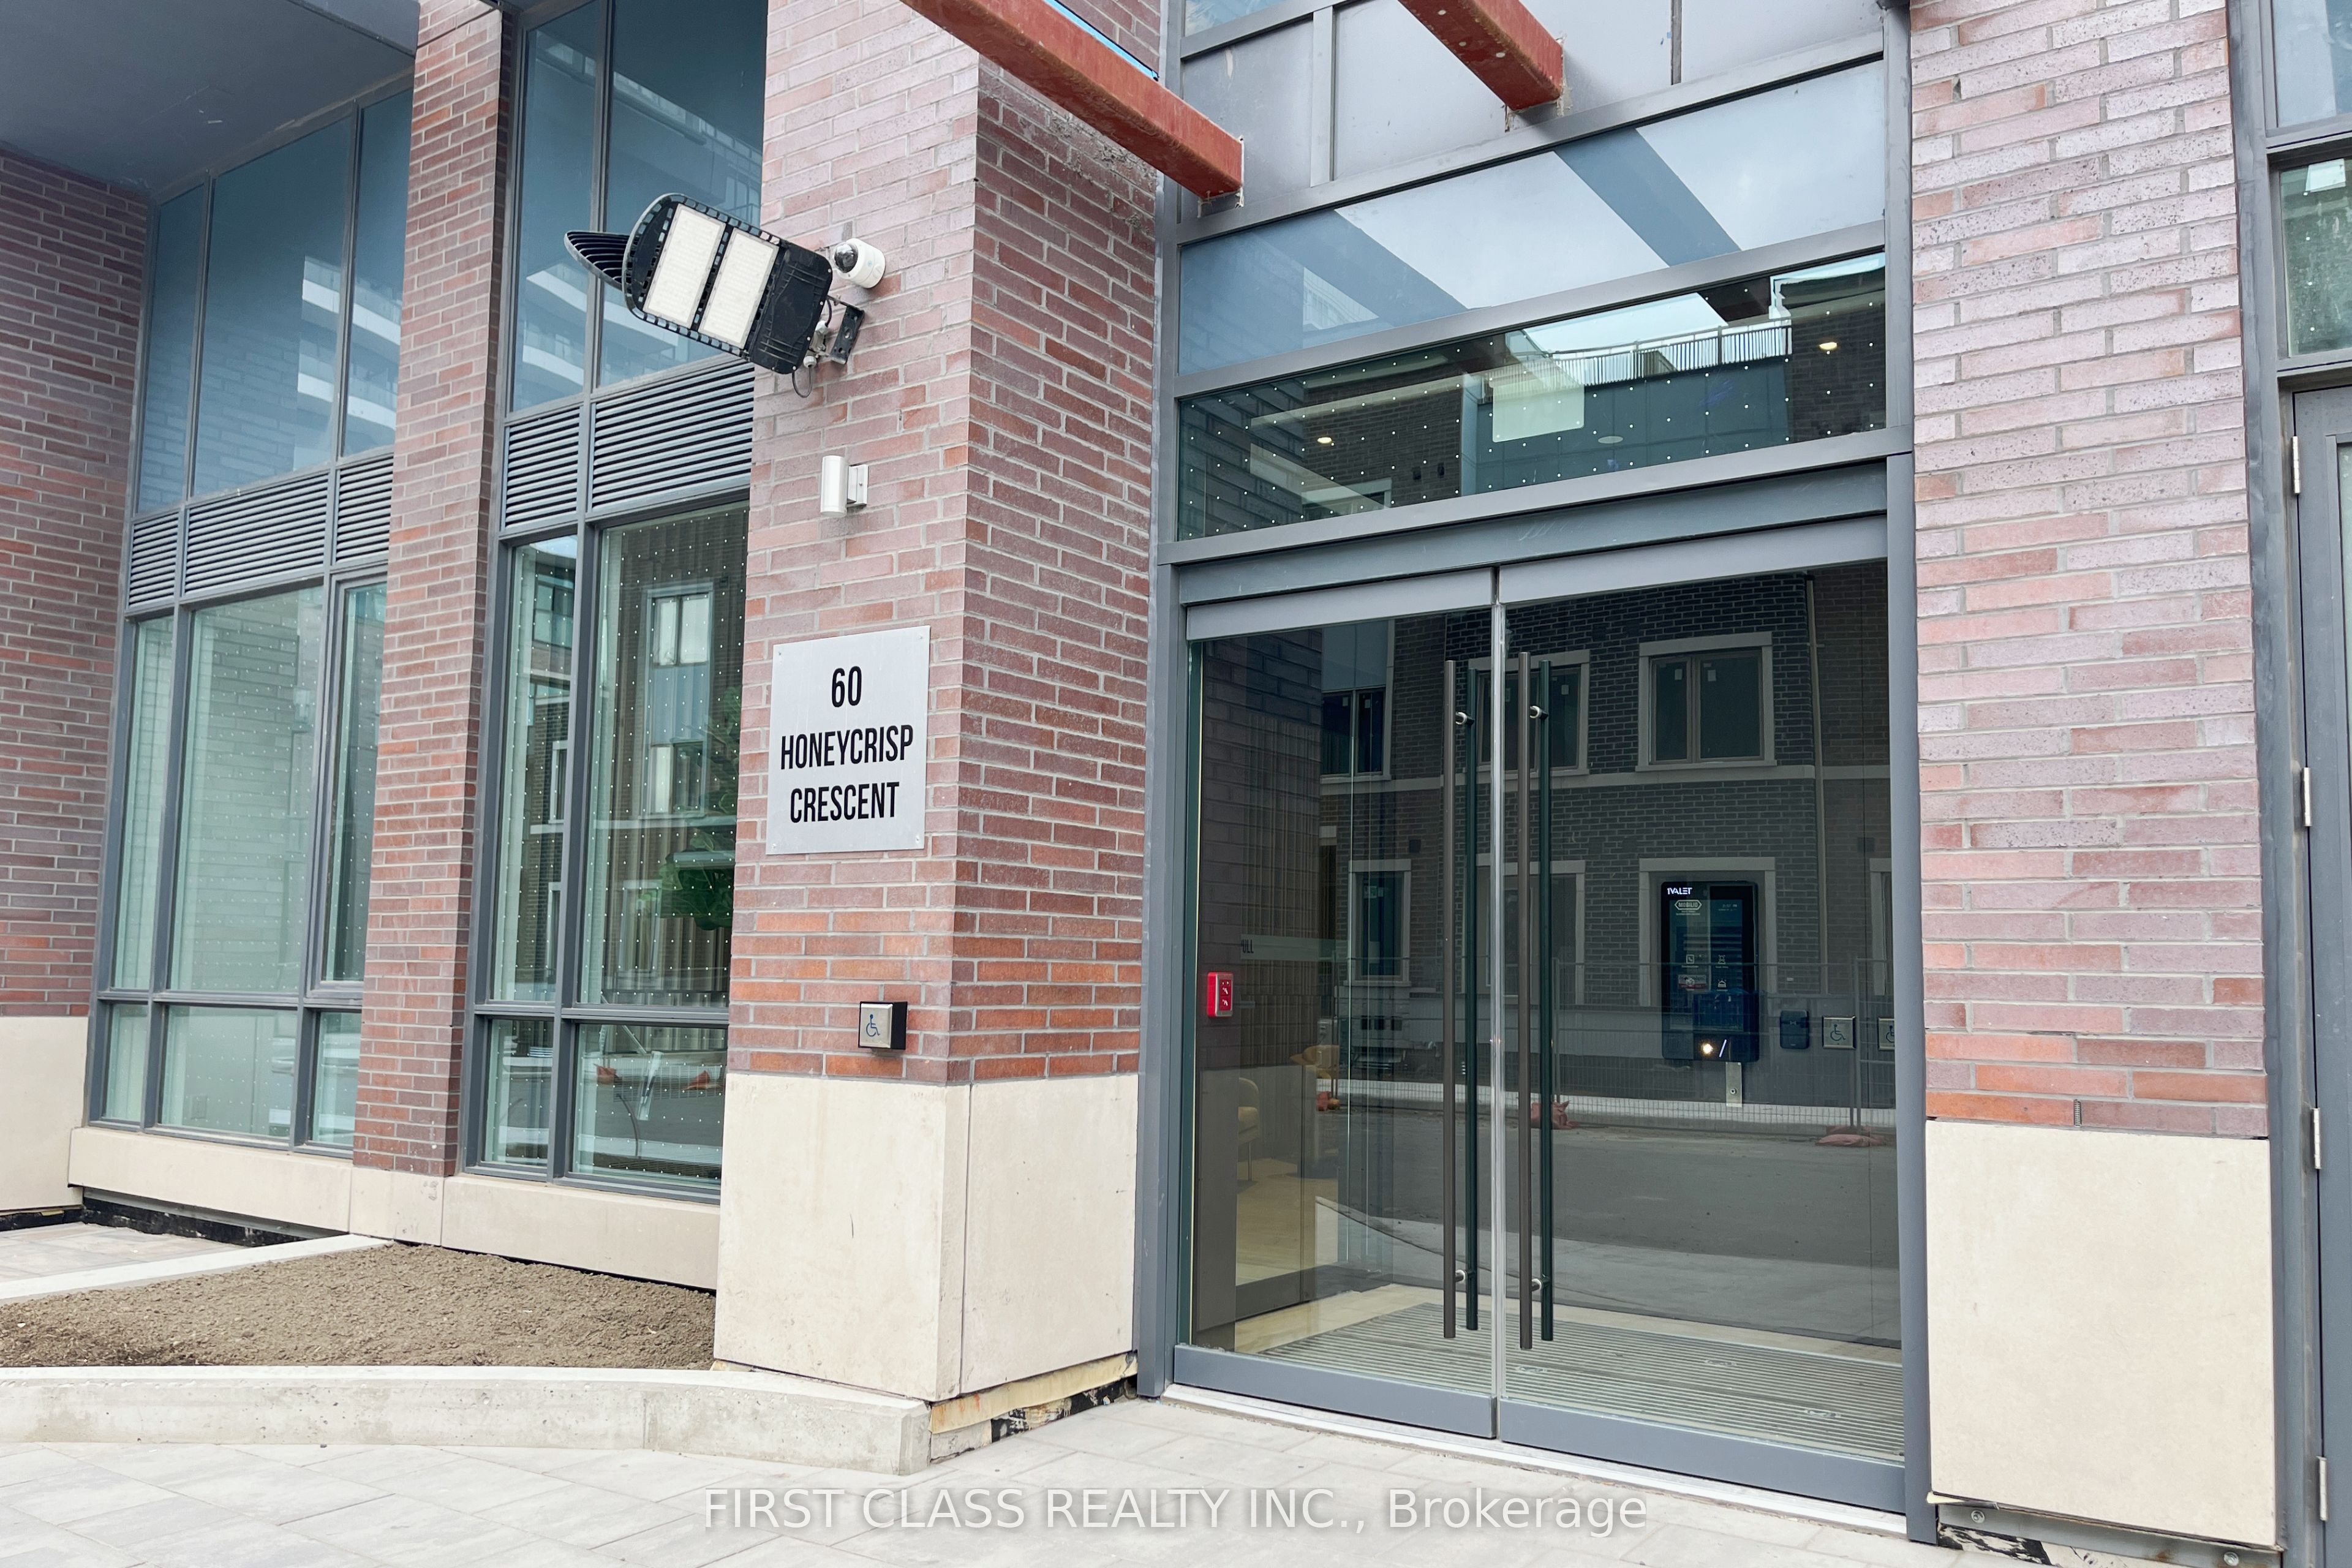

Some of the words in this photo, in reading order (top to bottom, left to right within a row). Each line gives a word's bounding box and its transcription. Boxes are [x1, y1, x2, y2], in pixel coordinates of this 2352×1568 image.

[831, 666, 862, 708] 60
[781, 725, 913, 770] HONEYCRISP
[790, 782, 900, 823] CRESCENT
